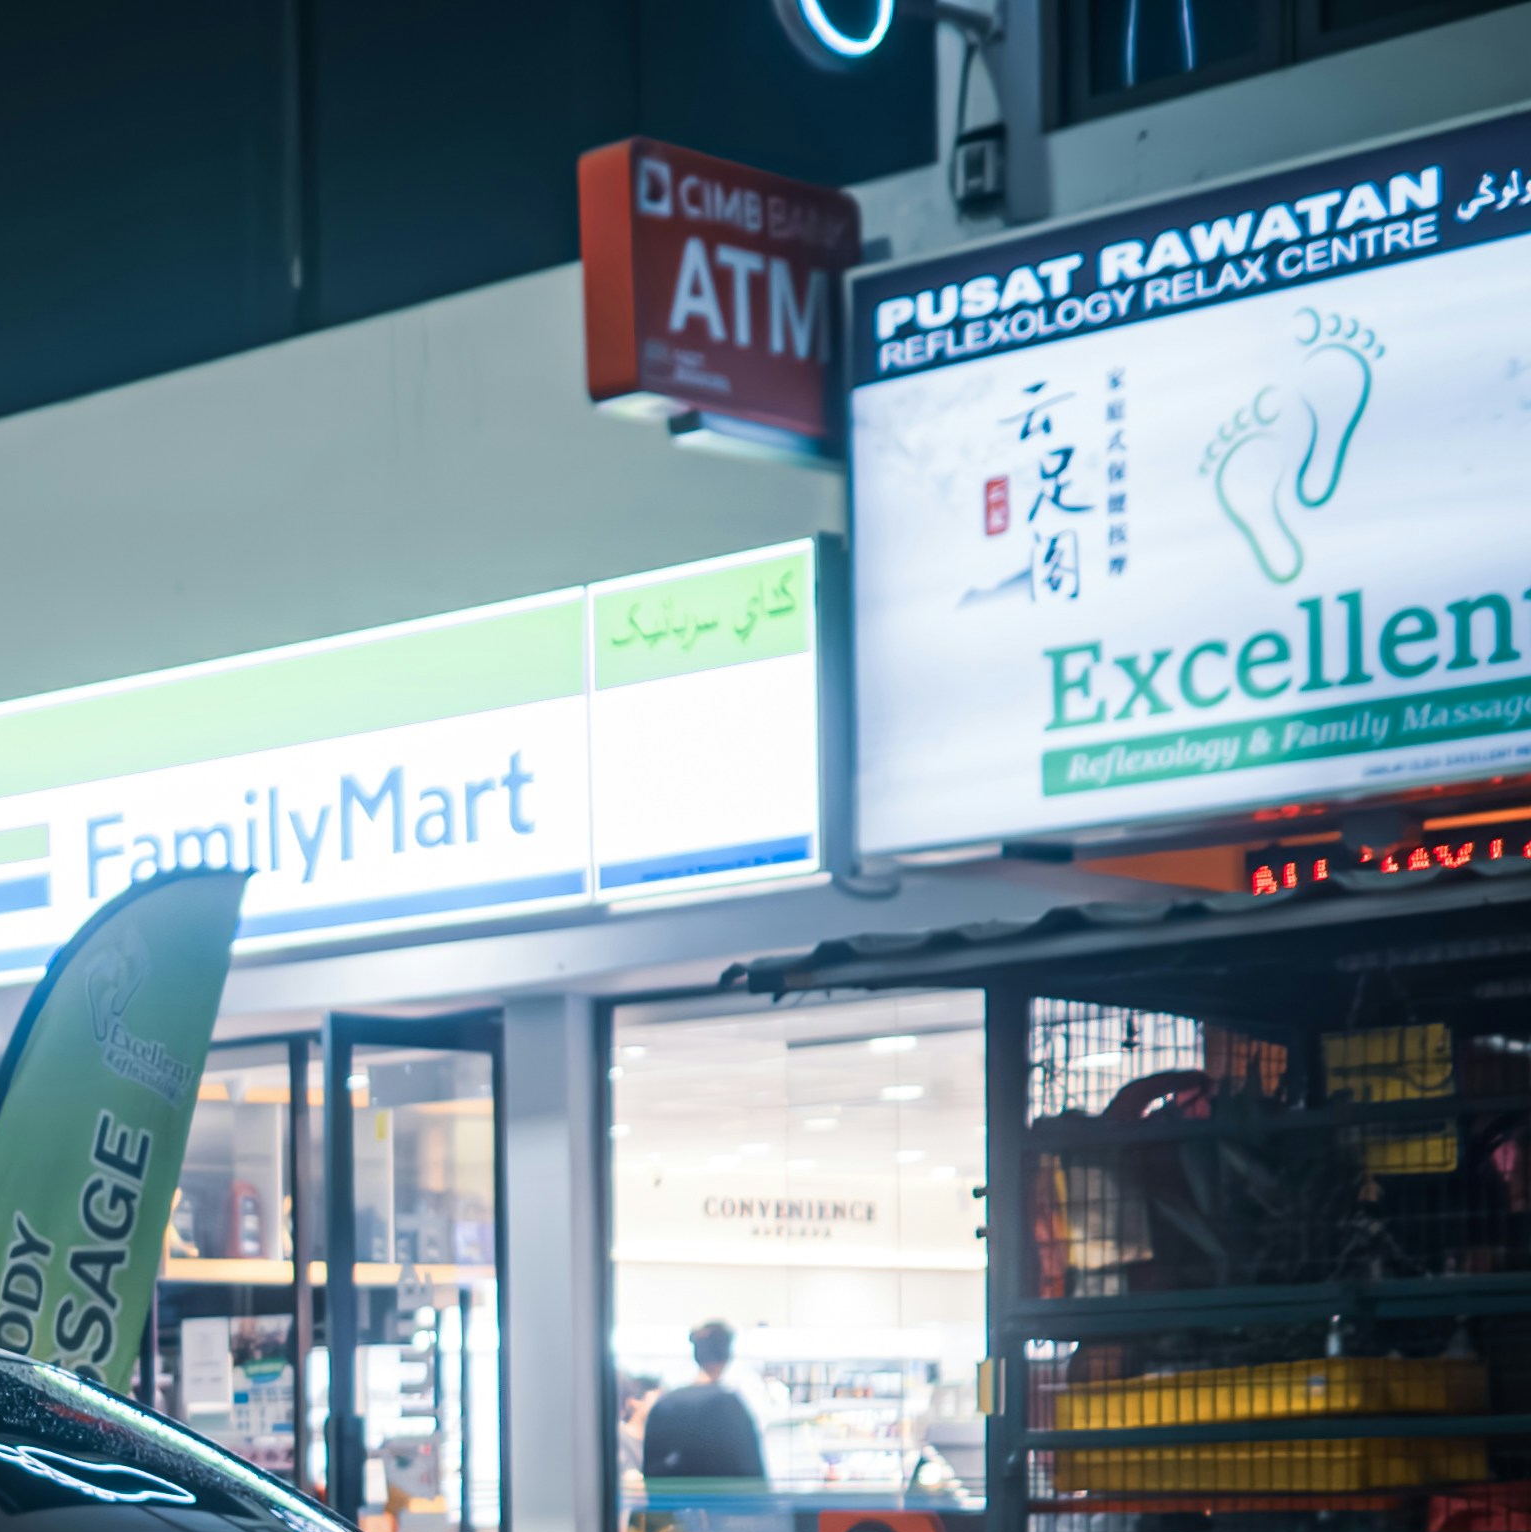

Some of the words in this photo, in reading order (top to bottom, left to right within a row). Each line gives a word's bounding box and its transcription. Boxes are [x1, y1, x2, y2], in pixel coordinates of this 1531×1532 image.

[679, 176, 763, 233] CIMB
[876, 253, 1082, 340] PUSAT
[1099, 166, 1440, 287] RAWATAN
[669, 236, 832, 364] ATM
[880, 287, 1136, 371] REFLEXOLOGY
[1145, 258, 1267, 310] RELAX
[1276, 215, 1439, 279] CENTRE
[1043, 588, 1531, 732] Excellen
[1068, 734, 1241, 785] Reflexology
[1248, 727, 1273, 756] &
[1281, 710, 1390, 751] Family
[86, 749, 536, 899] FamilyMart
[704, 1197, 876, 1222] CONVENIENCE
